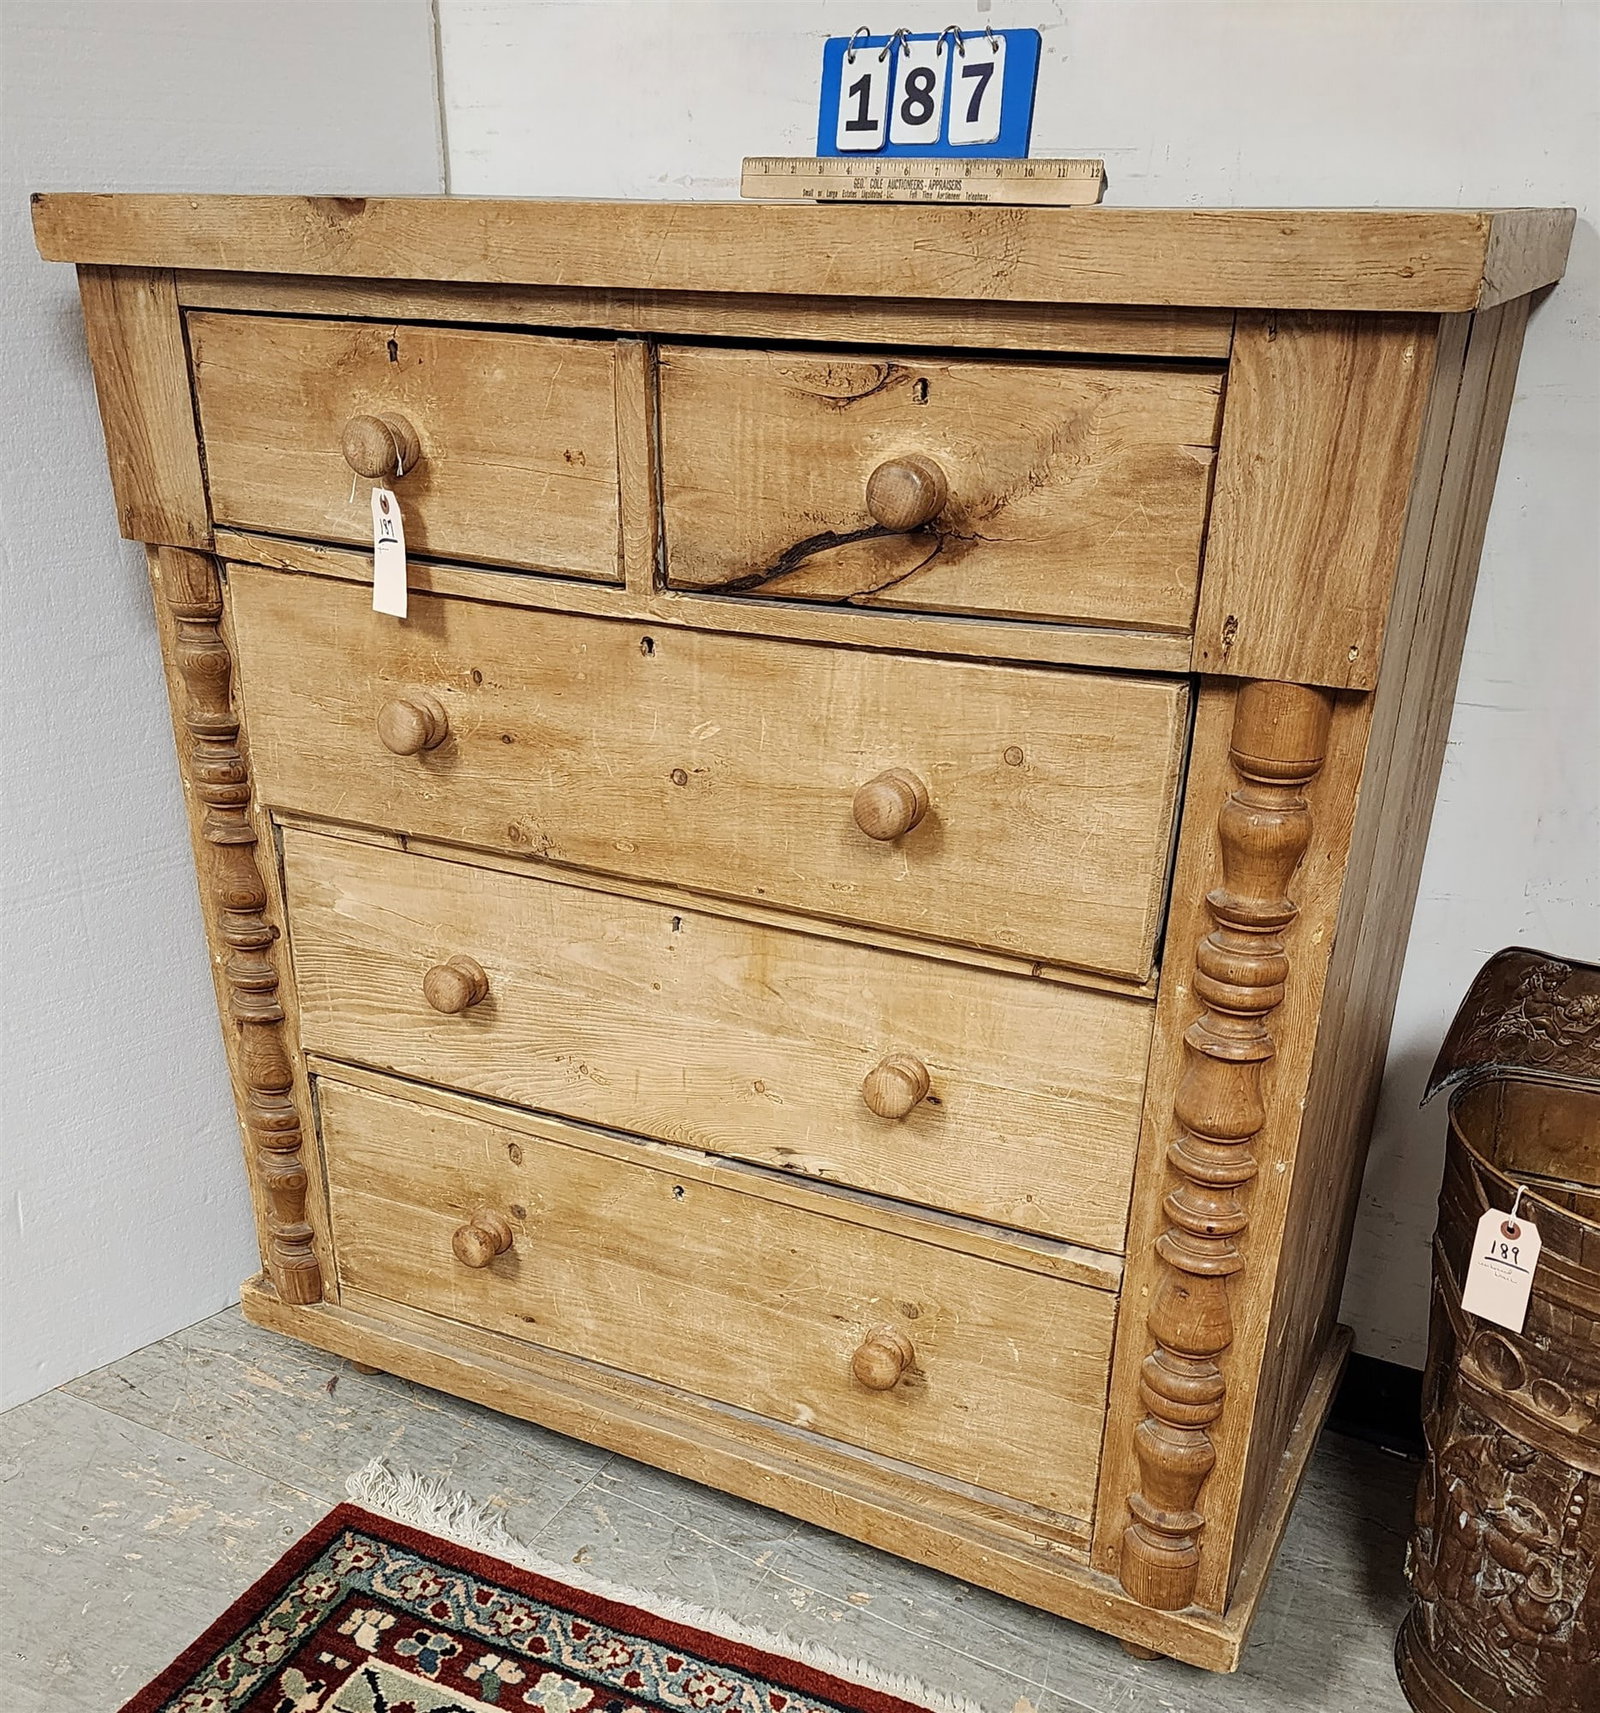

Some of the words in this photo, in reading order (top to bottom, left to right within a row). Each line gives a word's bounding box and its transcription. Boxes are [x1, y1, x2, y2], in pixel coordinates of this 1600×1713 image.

[845, 62, 994, 131] 187
[1024, 168, 1033, 177] 10
[1057, 168, 1066, 177] 11
[1090, 168, 1100, 178] 12
[870, 178, 883, 189] COLE
[1491, 1240, 1520, 1265] 189
